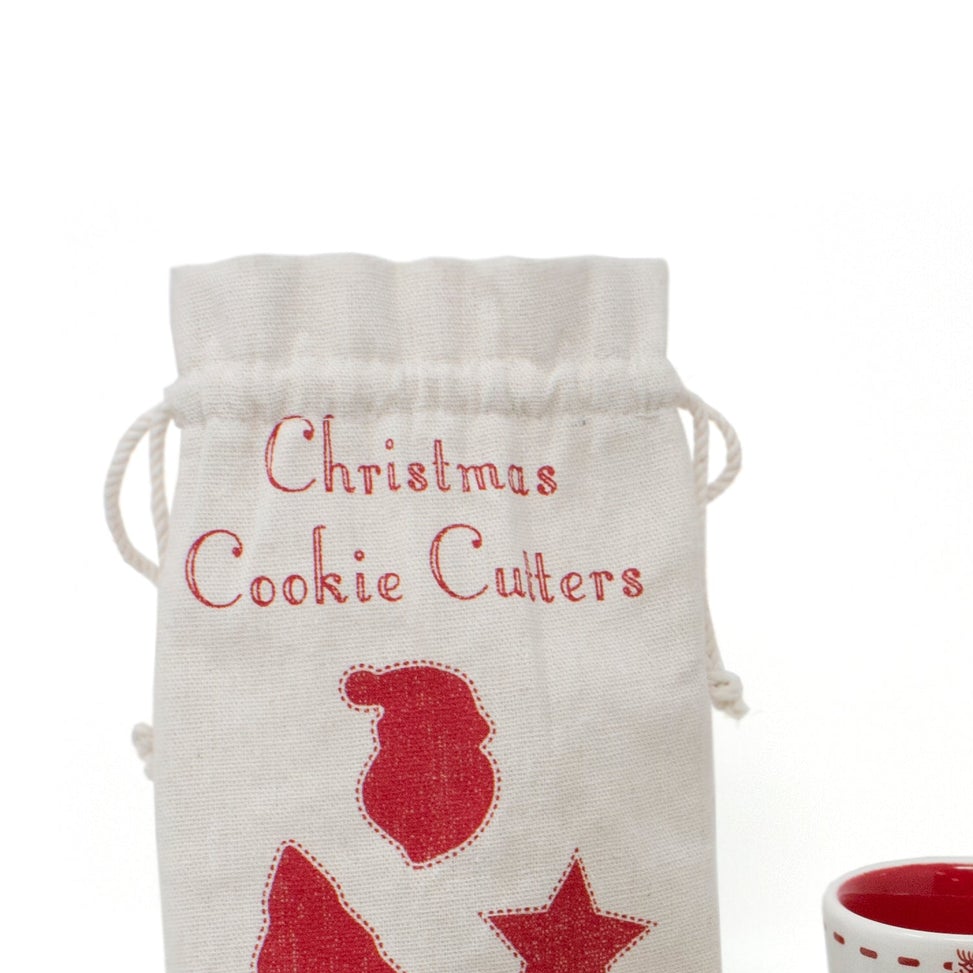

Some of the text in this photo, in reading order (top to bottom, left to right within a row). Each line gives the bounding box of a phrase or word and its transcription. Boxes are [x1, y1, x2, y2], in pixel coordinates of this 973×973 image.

[264, 414, 558, 496] Christmas
[185, 523, 645, 609] Cookie Cutters
